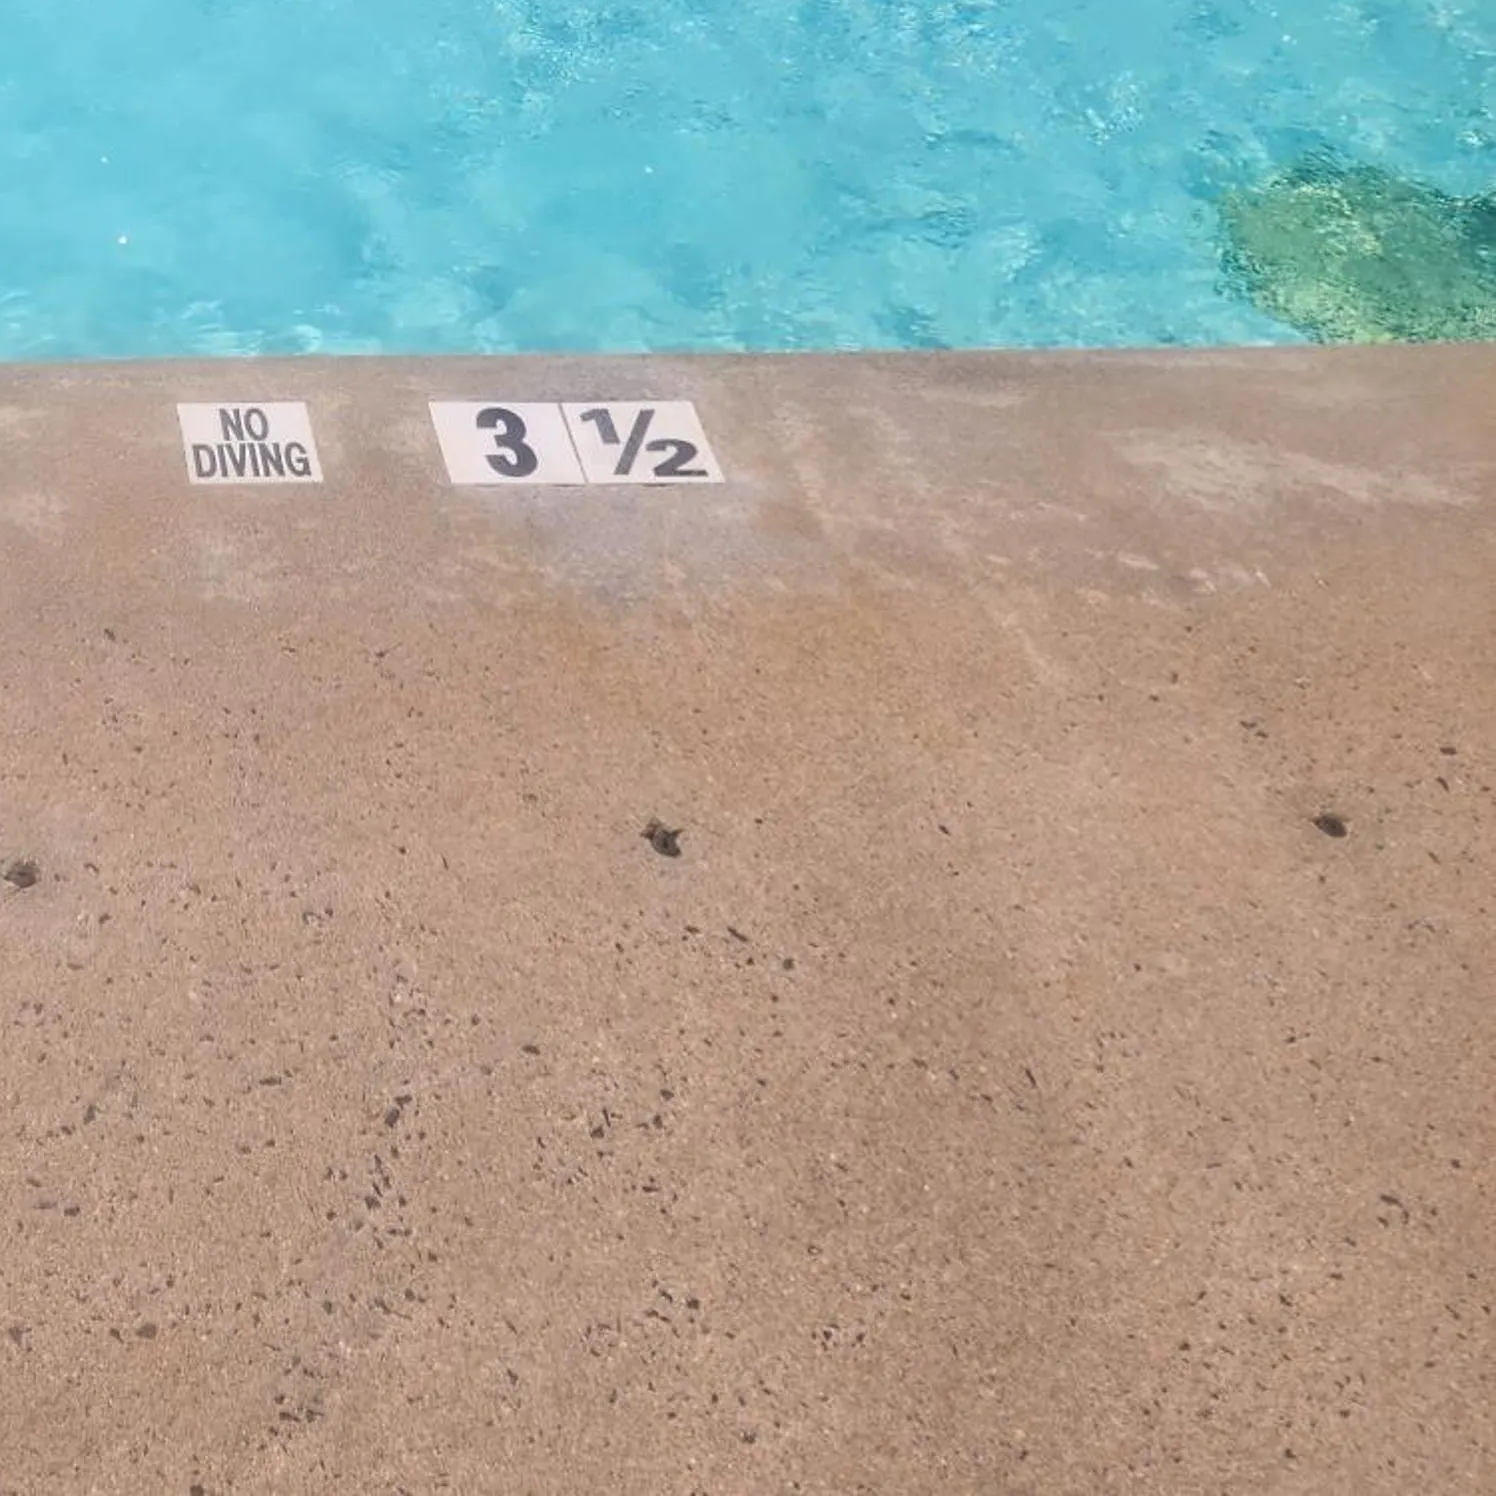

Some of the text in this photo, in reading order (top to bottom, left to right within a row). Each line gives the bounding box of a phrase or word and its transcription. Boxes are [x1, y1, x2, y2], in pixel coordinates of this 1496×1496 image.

[219, 408, 269, 441] NO
[476, 407, 538, 477] 3
[192, 442, 312, 477] DIVING
